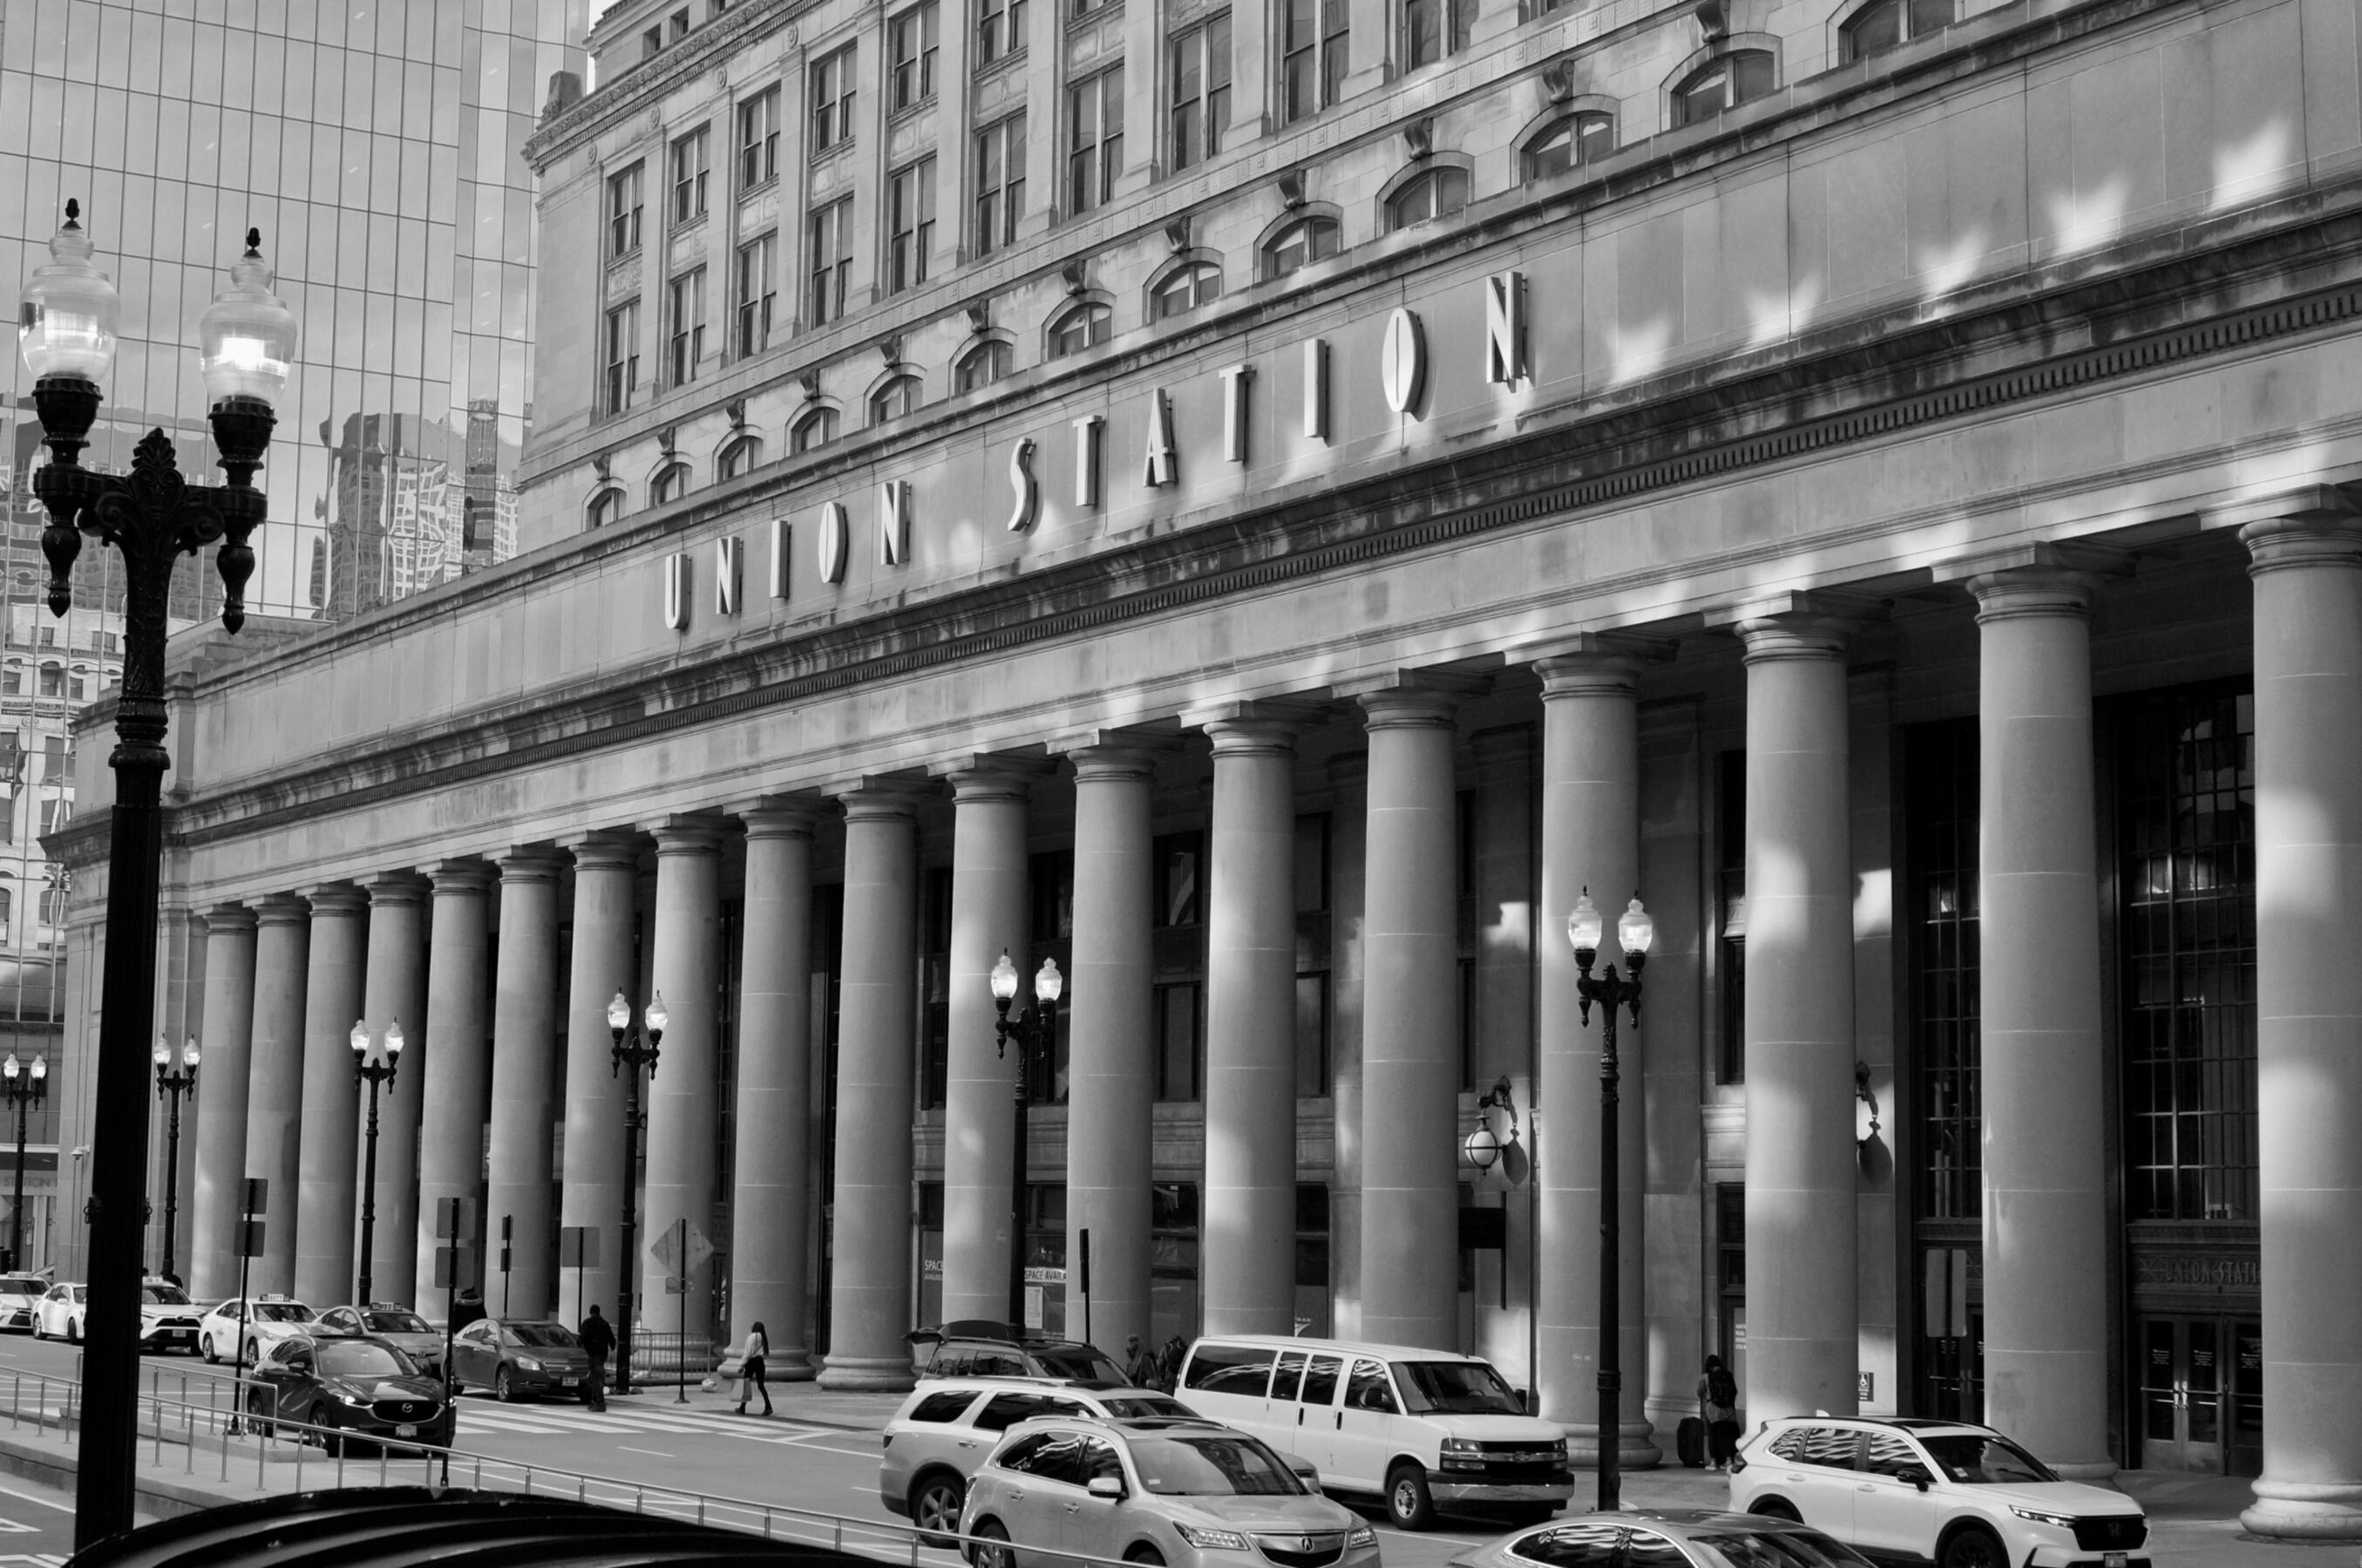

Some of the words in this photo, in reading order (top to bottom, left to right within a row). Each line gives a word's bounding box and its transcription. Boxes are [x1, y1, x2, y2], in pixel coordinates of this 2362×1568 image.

[664, 480, 912, 629] UNION
[1008, 271, 1523, 532] STATION
[3, 1177, 51, 1187] STTION
[924, 1259, 943, 1272] SPACE
[1024, 1269, 1044, 1280] SPACE
[2217, 1261, 2262, 1284] STATI
